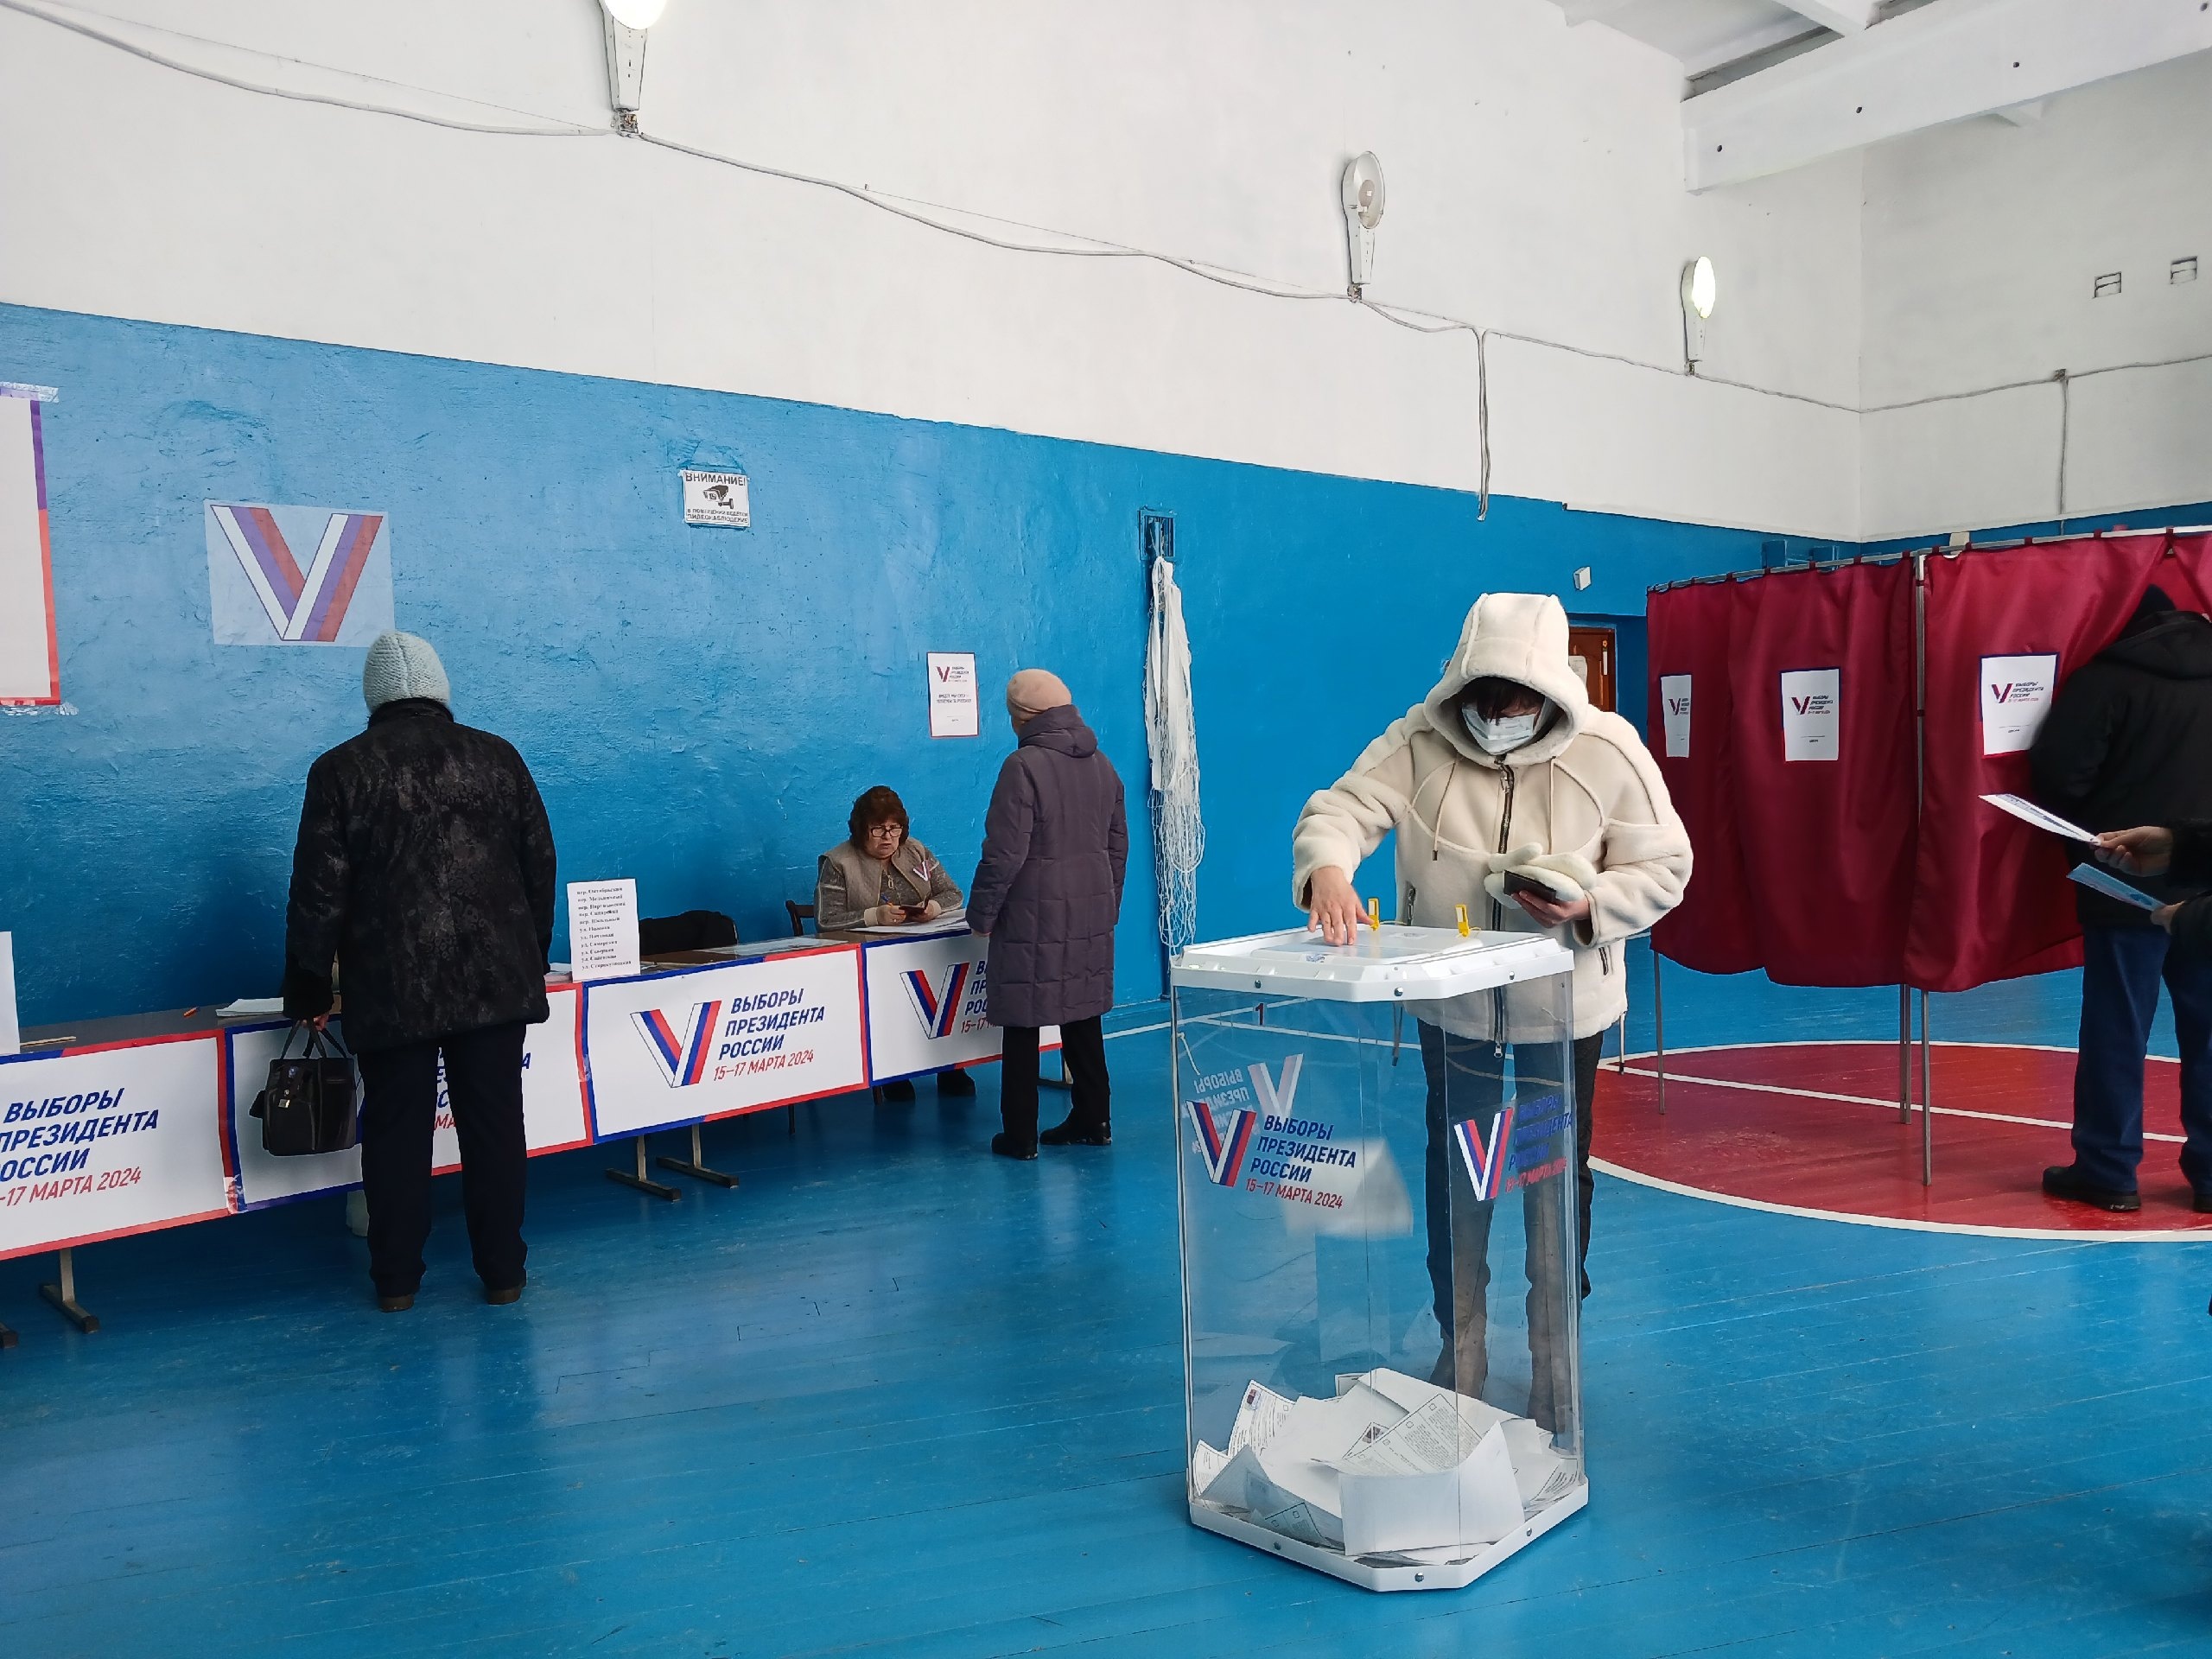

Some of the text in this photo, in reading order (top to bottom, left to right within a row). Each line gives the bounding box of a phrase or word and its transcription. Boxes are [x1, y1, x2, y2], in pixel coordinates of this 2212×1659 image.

[684, 472, 746, 486] ВНИМАНИЕ!
[730, 988, 804, 1014] ВЫБОРЫ
[725, 1006, 825, 1037] ПРЕЗИДЕНТА
[718, 1034, 785, 1060] РОССИИ
[747, 1054, 786, 1075] МАРТА
[787, 1049, 814, 1067] 2024
[3, 1088, 125, 1123] ВЫБОРЫ
[1263, 1115, 1334, 1141] ВЫБОРЫ
[1256, 1136, 1357, 1168] ПРЕЗИДЕНТА
[0, 1148, 91, 1183] ОССИИ
[1250, 1158, 1313, 1183] РОССИИ
[29, 1176, 93, 1203] МАРТА
[97, 1166, 142, 1192] 2024
[1274, 1185, 1313, 1205] МАРТА
[1314, 1192, 1343, 1210] 2024
